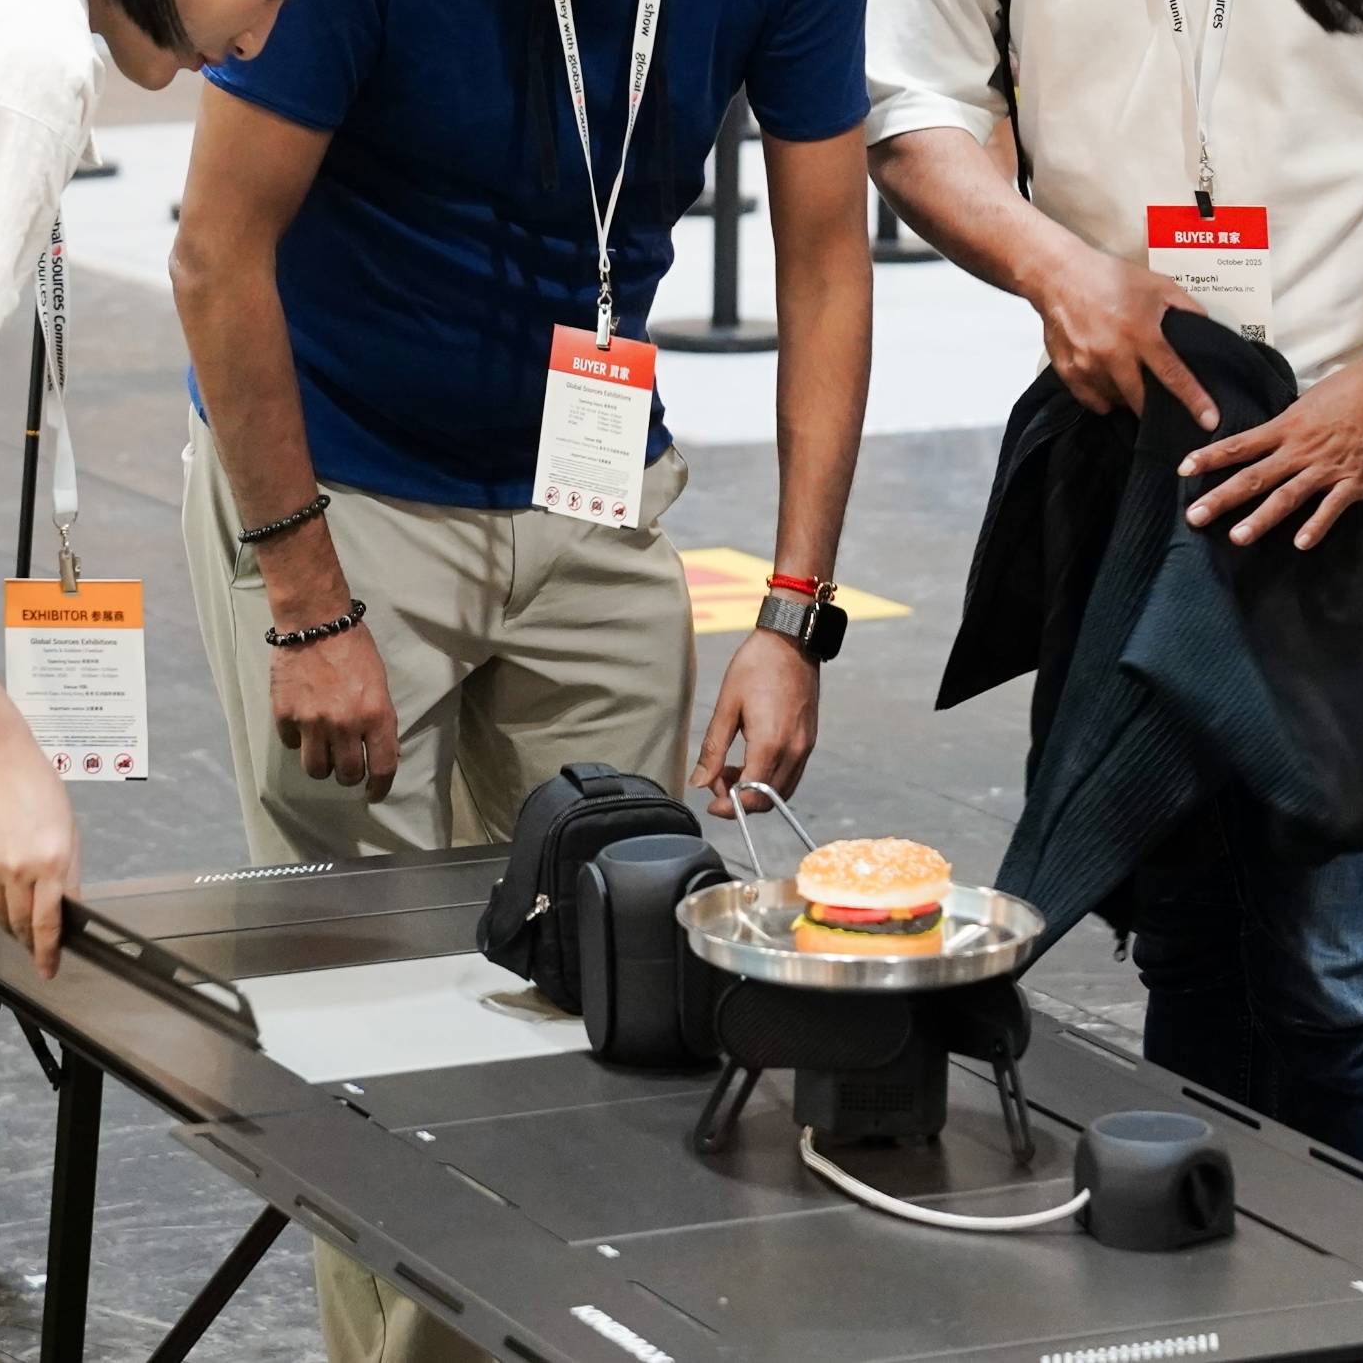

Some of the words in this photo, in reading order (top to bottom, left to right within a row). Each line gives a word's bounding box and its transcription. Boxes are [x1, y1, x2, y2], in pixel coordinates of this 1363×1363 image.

[640, 2, 656, 37] show
[563, 22, 574, 50] with
[567, 54, 582, 94] global
[633, 51, 647, 92] global
[1174, 231, 1214, 244] BUYER
[1217, 258, 1244, 266] October
[1245, 258, 1263, 266] 2025
[52, 255, 65, 311] sources
[1185, 274, 1219, 284] Taguchi
[1189, 285, 1211, 294] Japan
[572, 356, 607, 377] BUYER
[22, 609, 88, 622] EXHIBITOR
[30, 637, 52, 646] Global
[53, 637, 79, 646] Sources
[81, 637, 118, 647] Exhibitions
